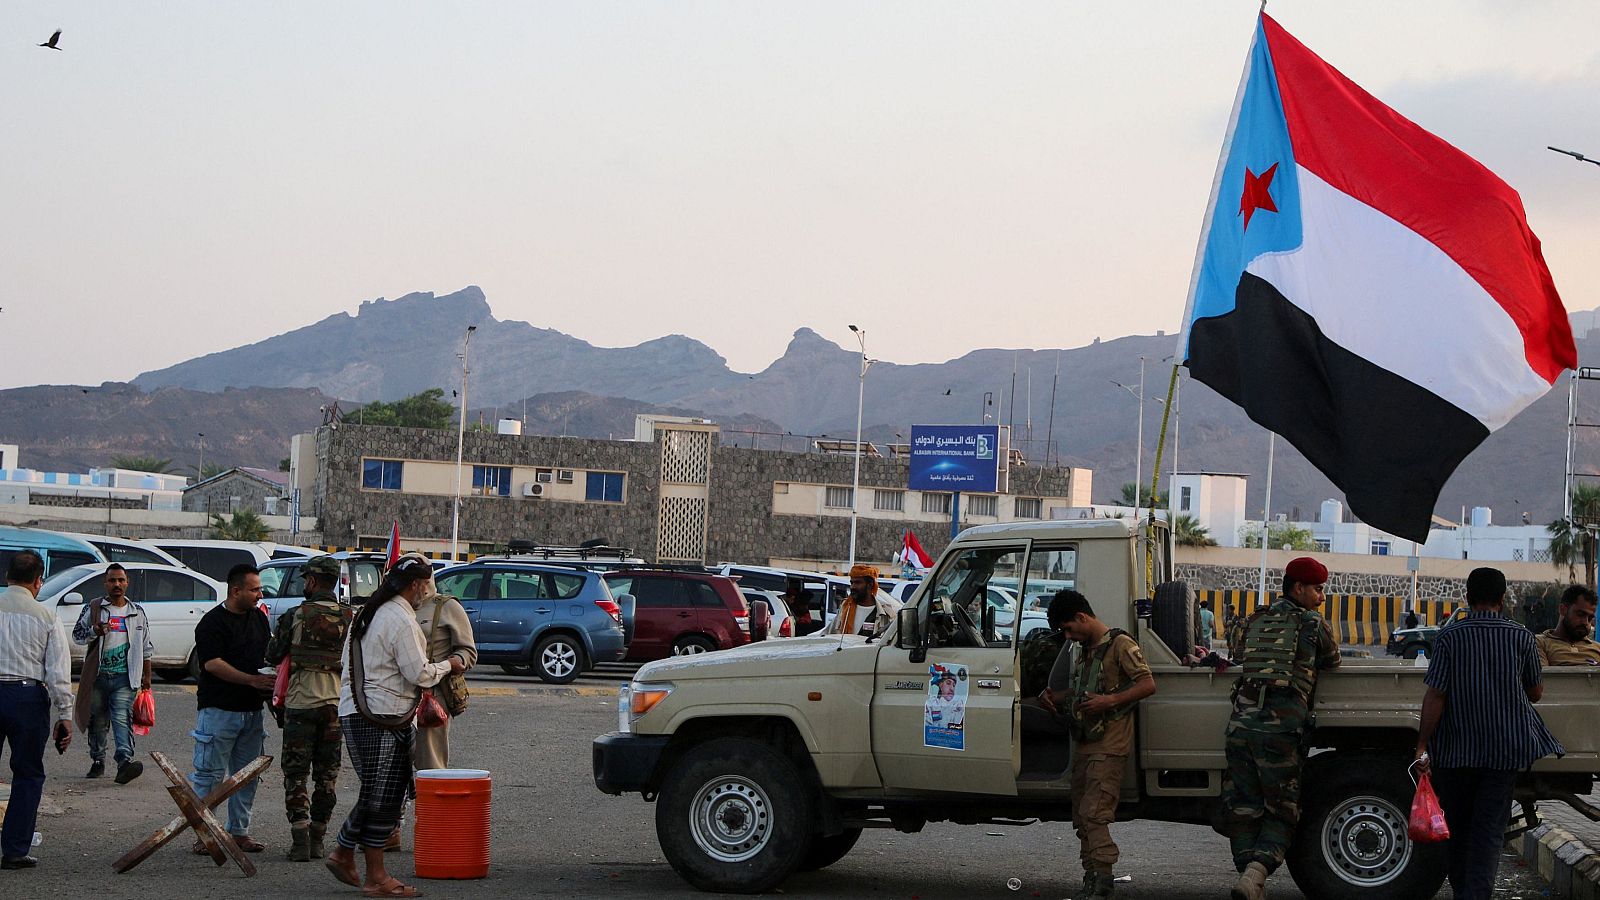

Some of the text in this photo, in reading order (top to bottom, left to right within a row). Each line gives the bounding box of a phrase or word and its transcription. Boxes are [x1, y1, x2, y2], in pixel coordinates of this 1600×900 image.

[915, 436, 976, 448] بنك البسيري الدولي
